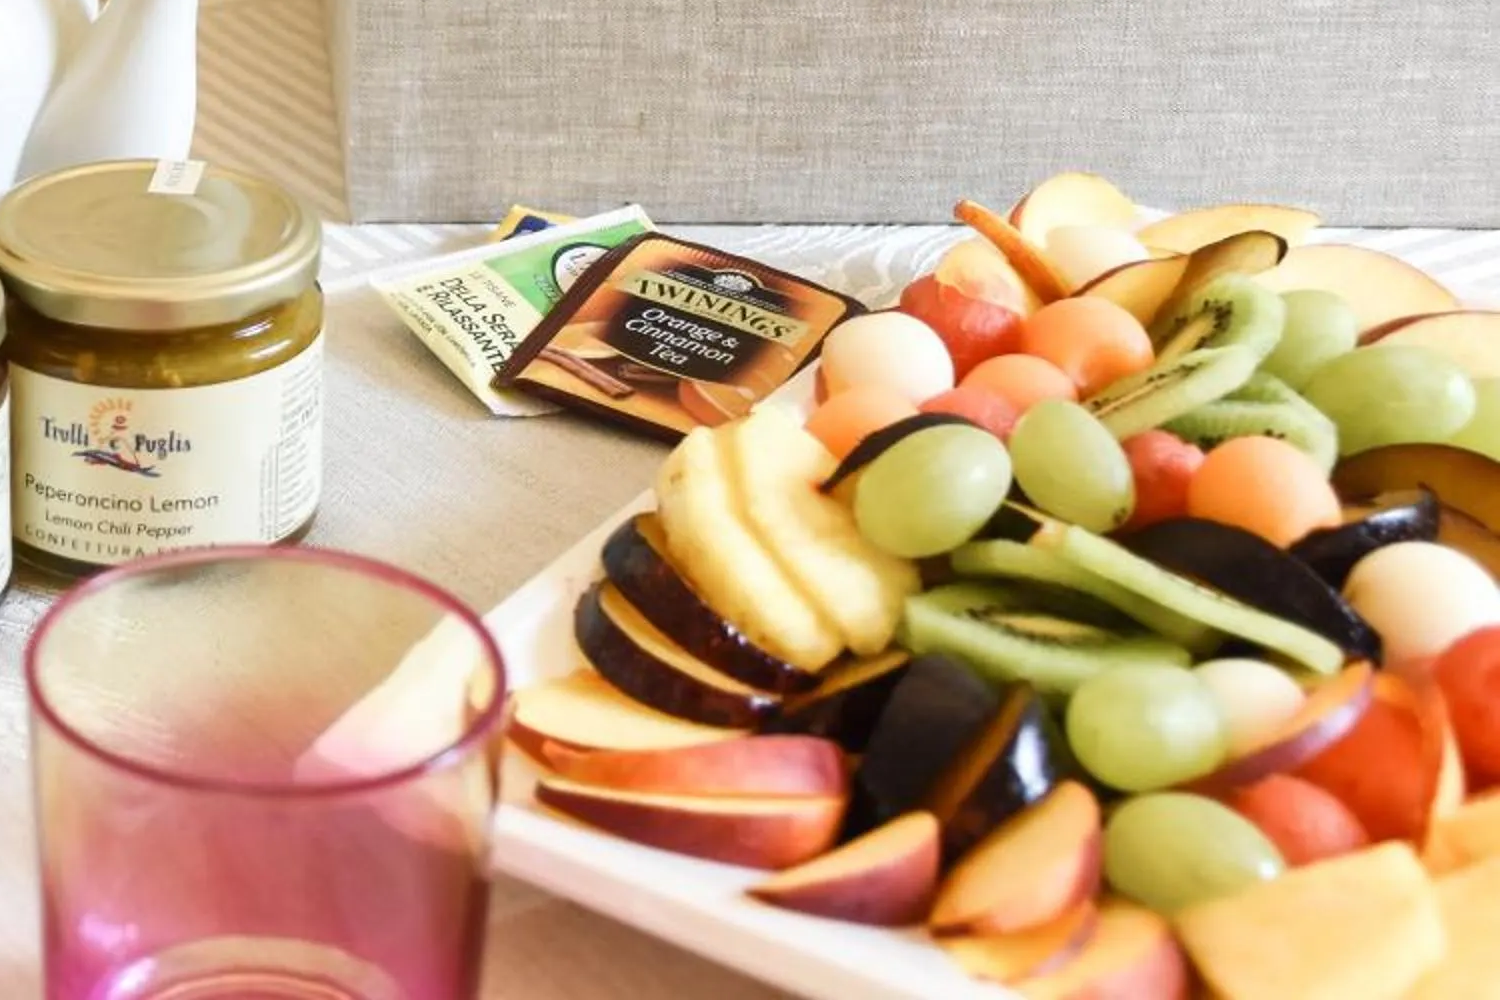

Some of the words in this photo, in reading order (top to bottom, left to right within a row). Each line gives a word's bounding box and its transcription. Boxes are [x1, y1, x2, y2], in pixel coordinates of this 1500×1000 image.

[440, 277, 486, 313] DELLA
[483, 313, 521, 353] SERA
[634, 278, 791, 339] TWININGS
[642, 308, 723, 342] Orange
[722, 337, 740, 349] &
[625, 319, 735, 365] Cinnamon
[649, 342, 688, 365] Tea
[40, 415, 89, 446] Trulli
[24, 473, 143, 512] Peperoncino
[150, 495, 219, 513] Lemon
[45, 510, 93, 532] Lemon
[97, 520, 131, 536] Chili
[136, 523, 194, 540] Pepper
